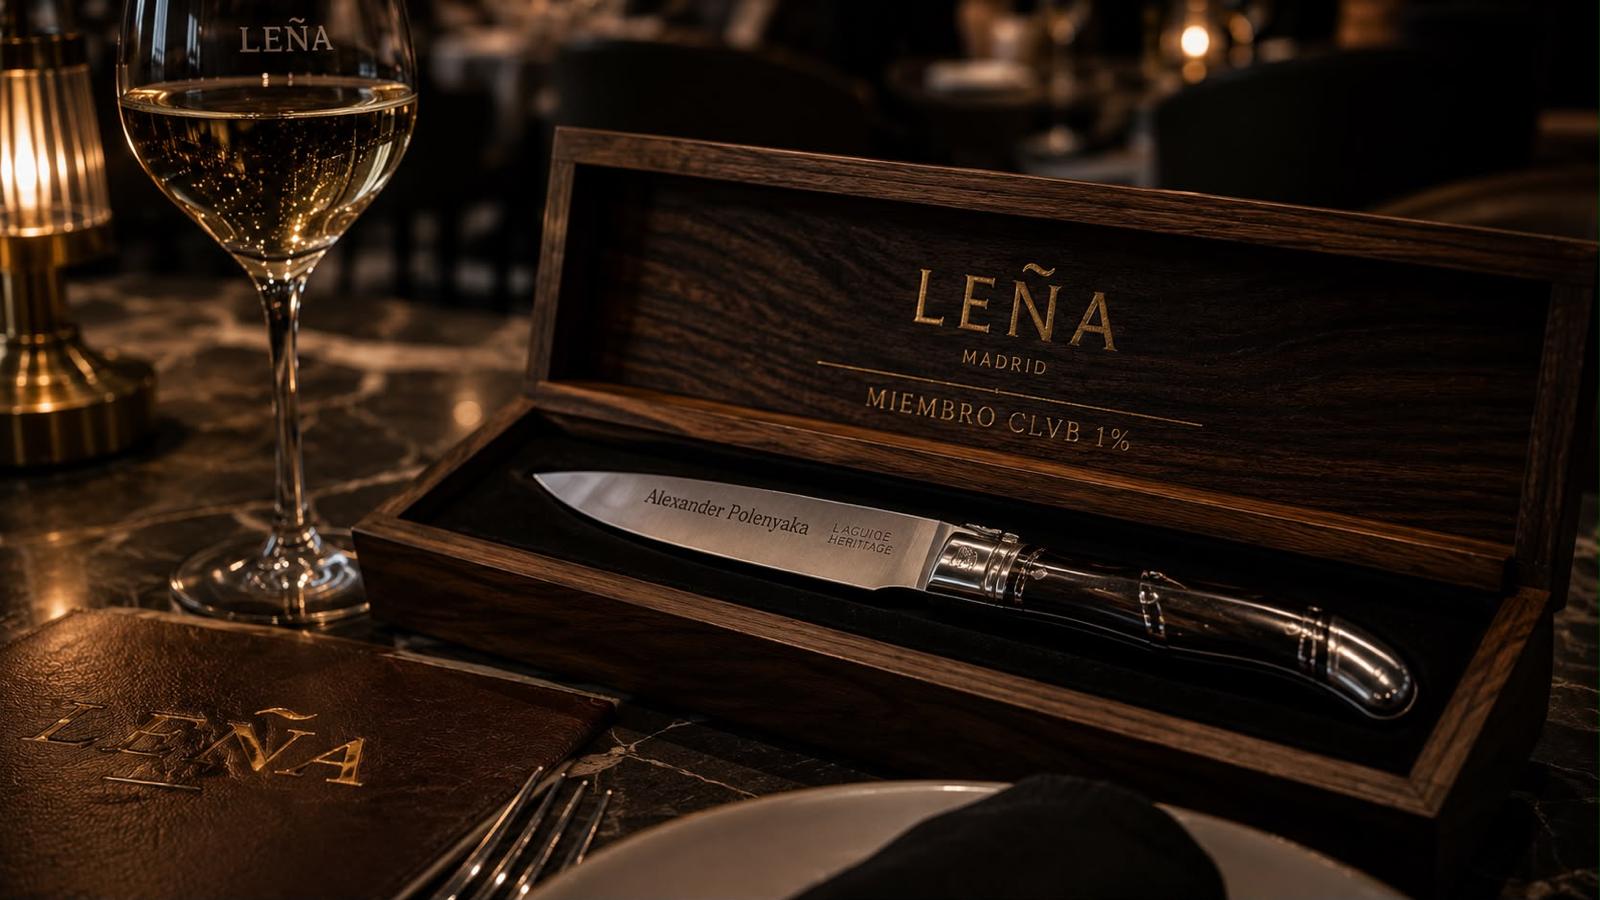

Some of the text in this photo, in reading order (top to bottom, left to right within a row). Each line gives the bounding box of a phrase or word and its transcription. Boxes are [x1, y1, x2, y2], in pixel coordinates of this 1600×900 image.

[239, 17, 334, 52] LEÑA
[912, 262, 1118, 351] LEÑA
[962, 349, 1047, 375] MADRID
[865, 387, 1130, 452] MIEMBRO CLVB 1%
[644, 488, 809, 536] Alexander Polenyaka
[20, 702, 366, 787] LEÑA
